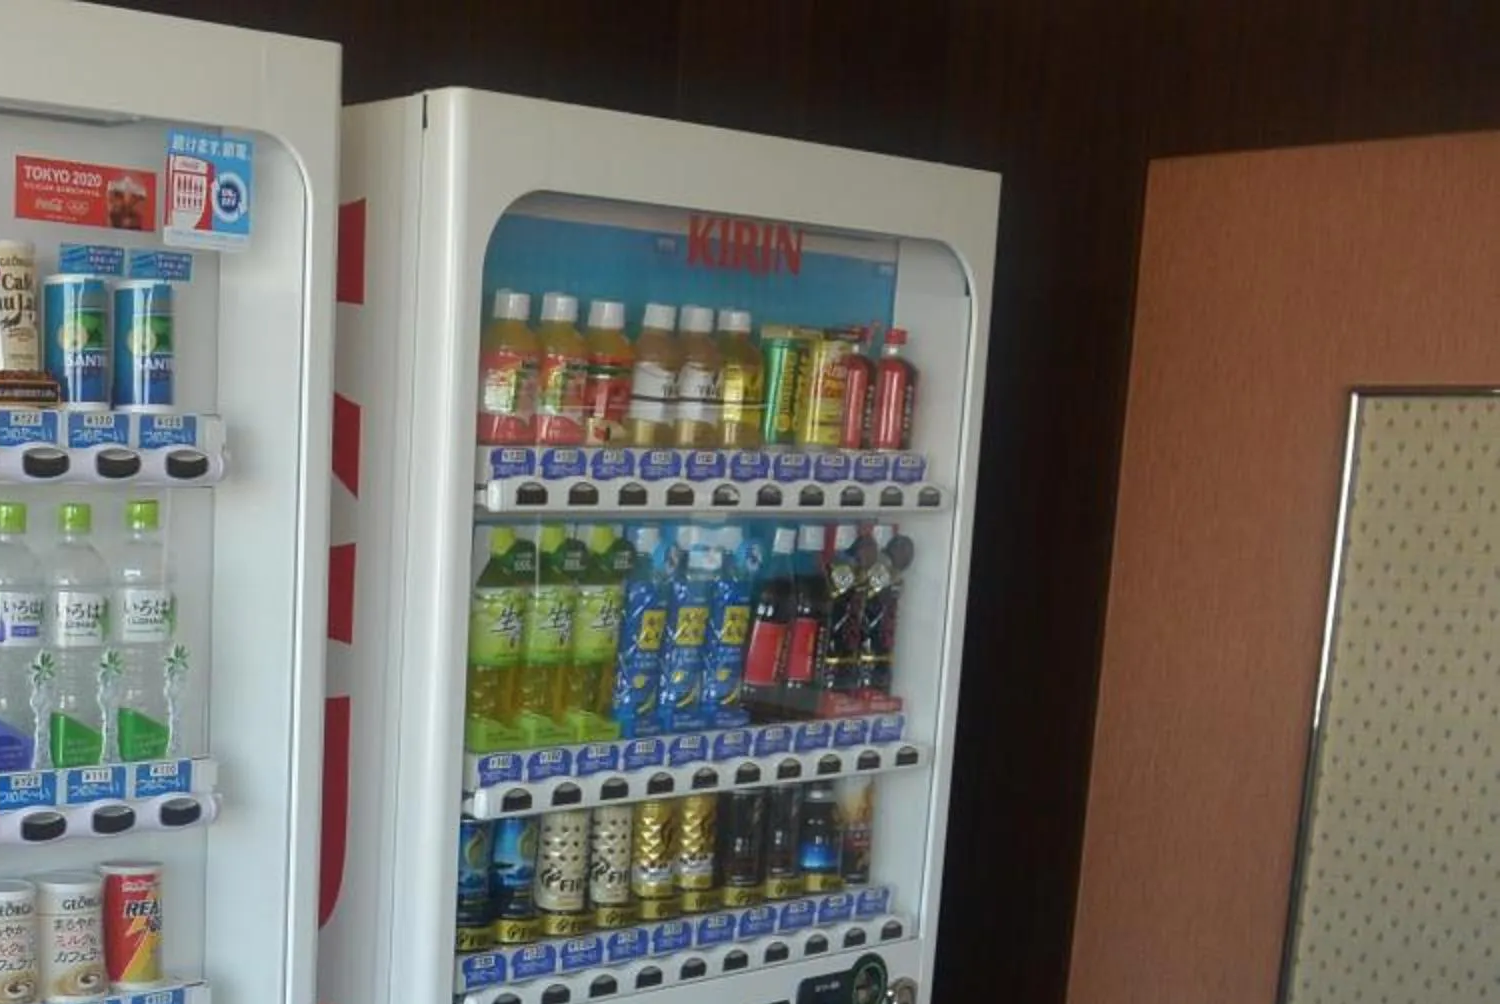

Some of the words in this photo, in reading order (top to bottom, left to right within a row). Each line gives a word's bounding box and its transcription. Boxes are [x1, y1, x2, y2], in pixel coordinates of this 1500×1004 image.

[23, 165, 71, 185] TOKYO
[73, 170, 102, 187] 2020
[687, 214, 803, 275] KIRIN
